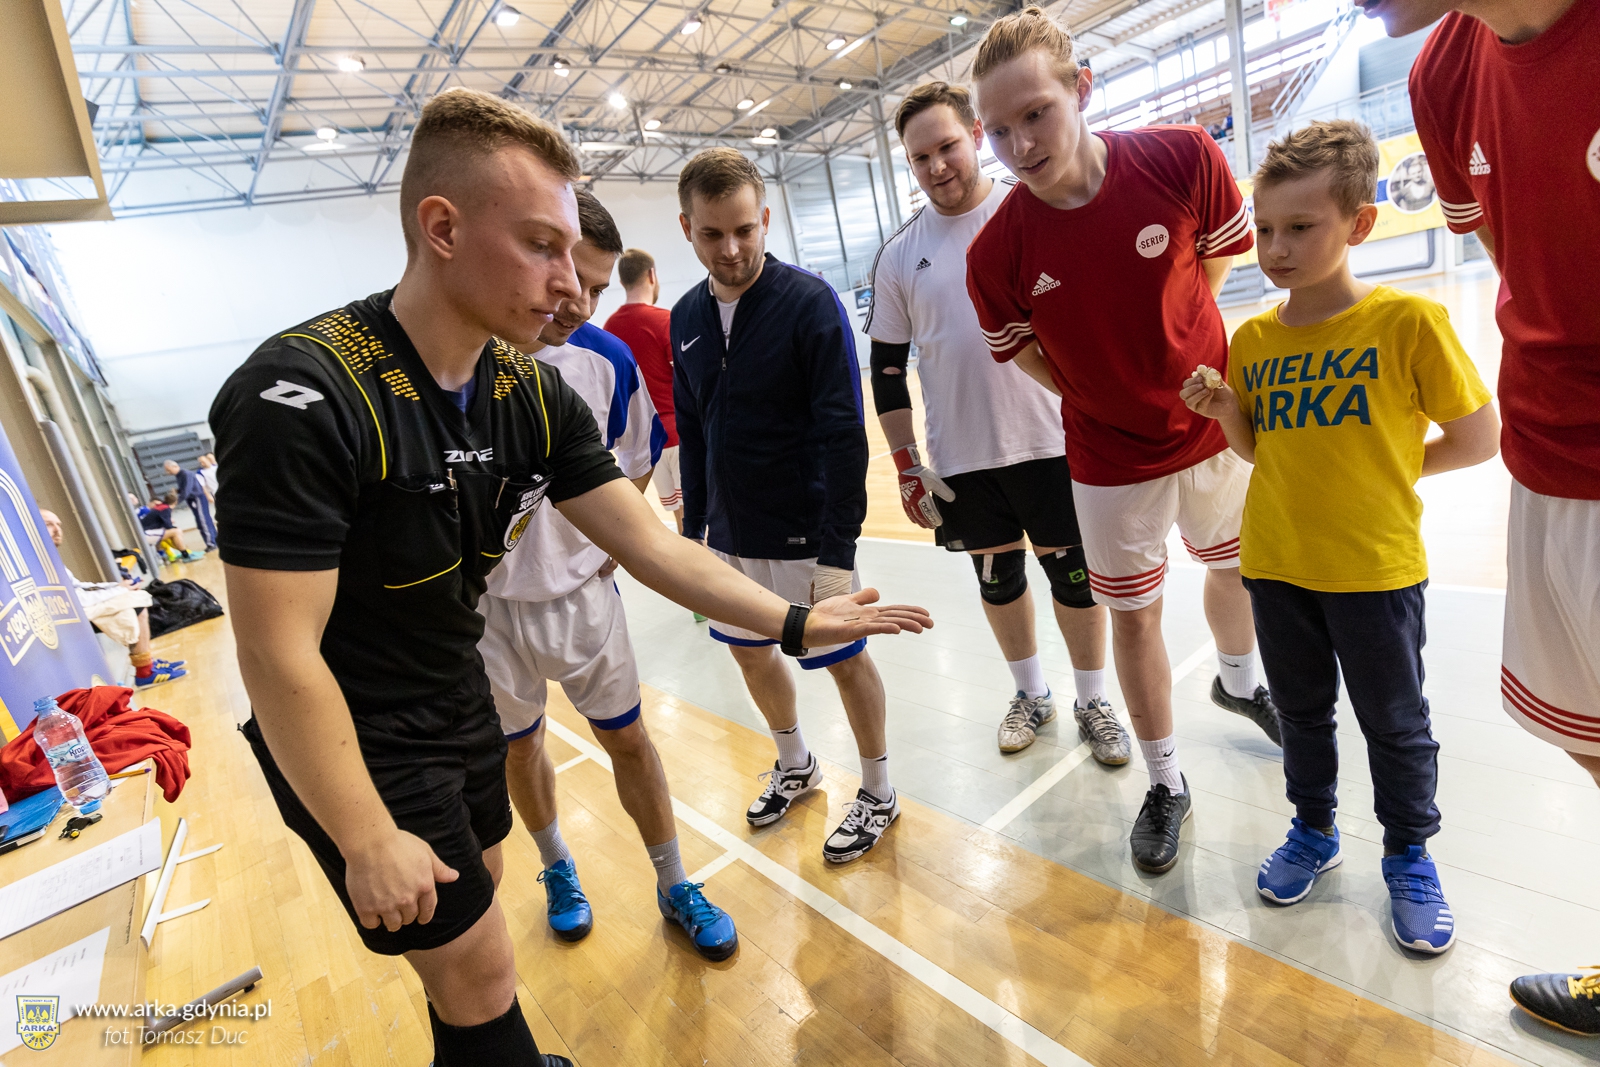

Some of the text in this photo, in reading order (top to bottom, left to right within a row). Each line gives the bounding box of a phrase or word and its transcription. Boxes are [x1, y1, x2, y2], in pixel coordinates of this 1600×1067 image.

[1031, 279, 1062, 297] adidas
[1243, 347, 1379, 393] WIELKA
[1253, 384, 1372, 433] ARKA
